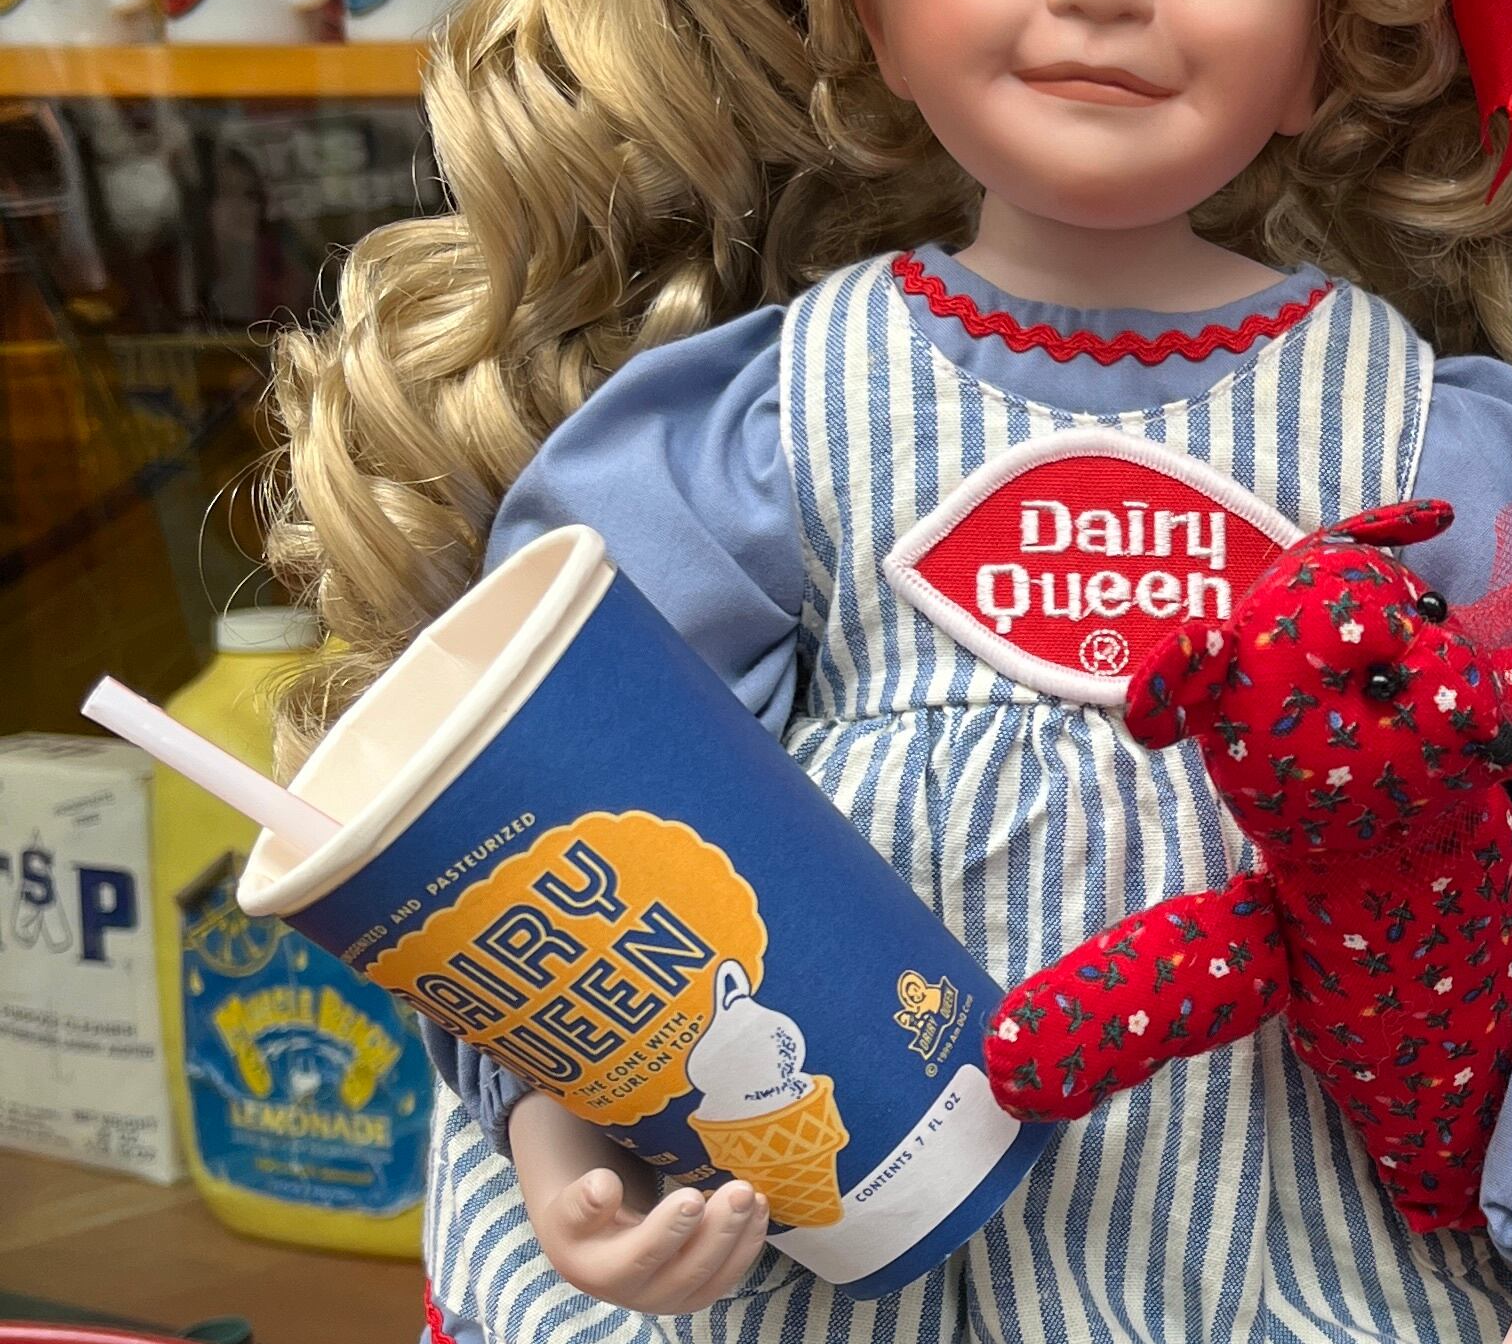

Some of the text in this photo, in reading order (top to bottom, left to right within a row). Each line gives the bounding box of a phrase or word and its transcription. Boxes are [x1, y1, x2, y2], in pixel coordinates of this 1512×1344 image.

[1019, 499, 1227, 571] Dairy
[975, 562, 1234, 635] Queen
[389, 898, 423, 925] AND
[426, 811, 538, 897] PASTEURIZED
[586, 1094, 613, 1110] THE
[612, 1073, 649, 1099] CURL
[647, 1051, 673, 1073] ON
[606, 1050, 648, 1083] CONE
[645, 1011, 689, 1050] WITH
[231, 1101, 392, 1149] LEMONADE
[855, 1092, 961, 1203] CONTENTS 7 FL OZ
